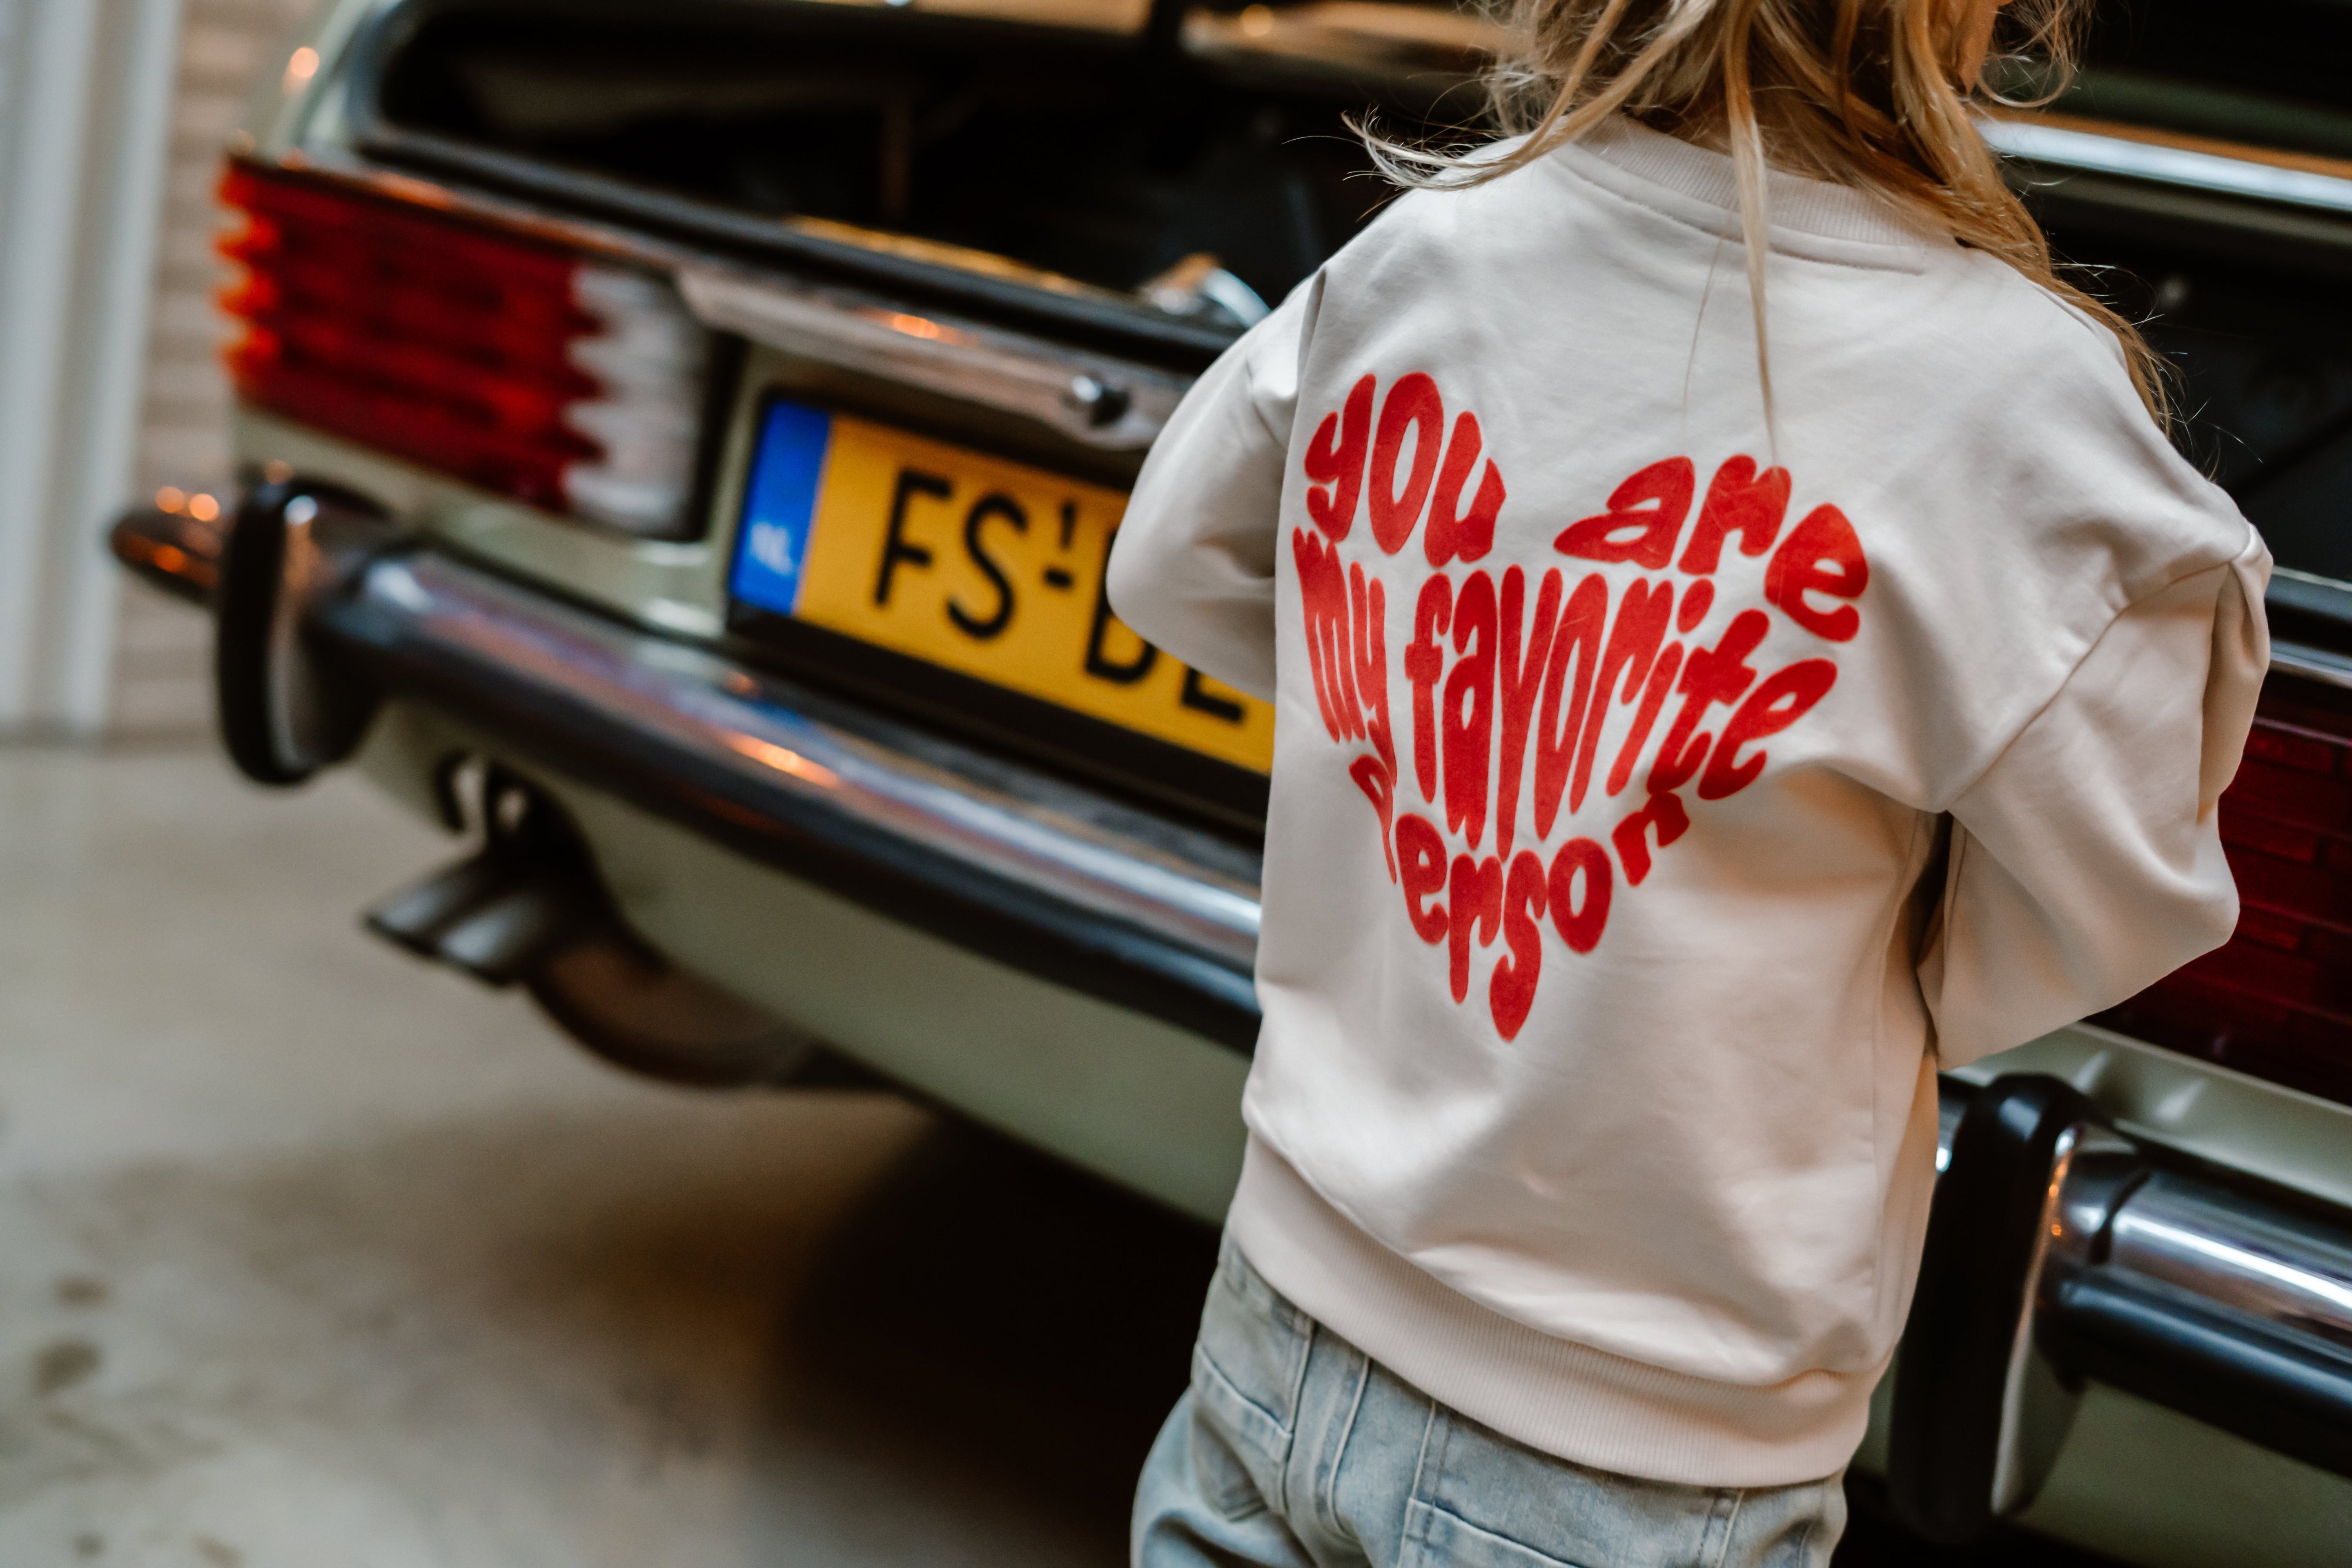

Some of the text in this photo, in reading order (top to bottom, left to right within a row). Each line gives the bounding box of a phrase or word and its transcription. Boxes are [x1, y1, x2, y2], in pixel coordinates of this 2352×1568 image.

[1304, 372, 1870, 643] you are
[1292, 526, 1838, 863] my favorite
[1348, 754, 1690, 1042] person
